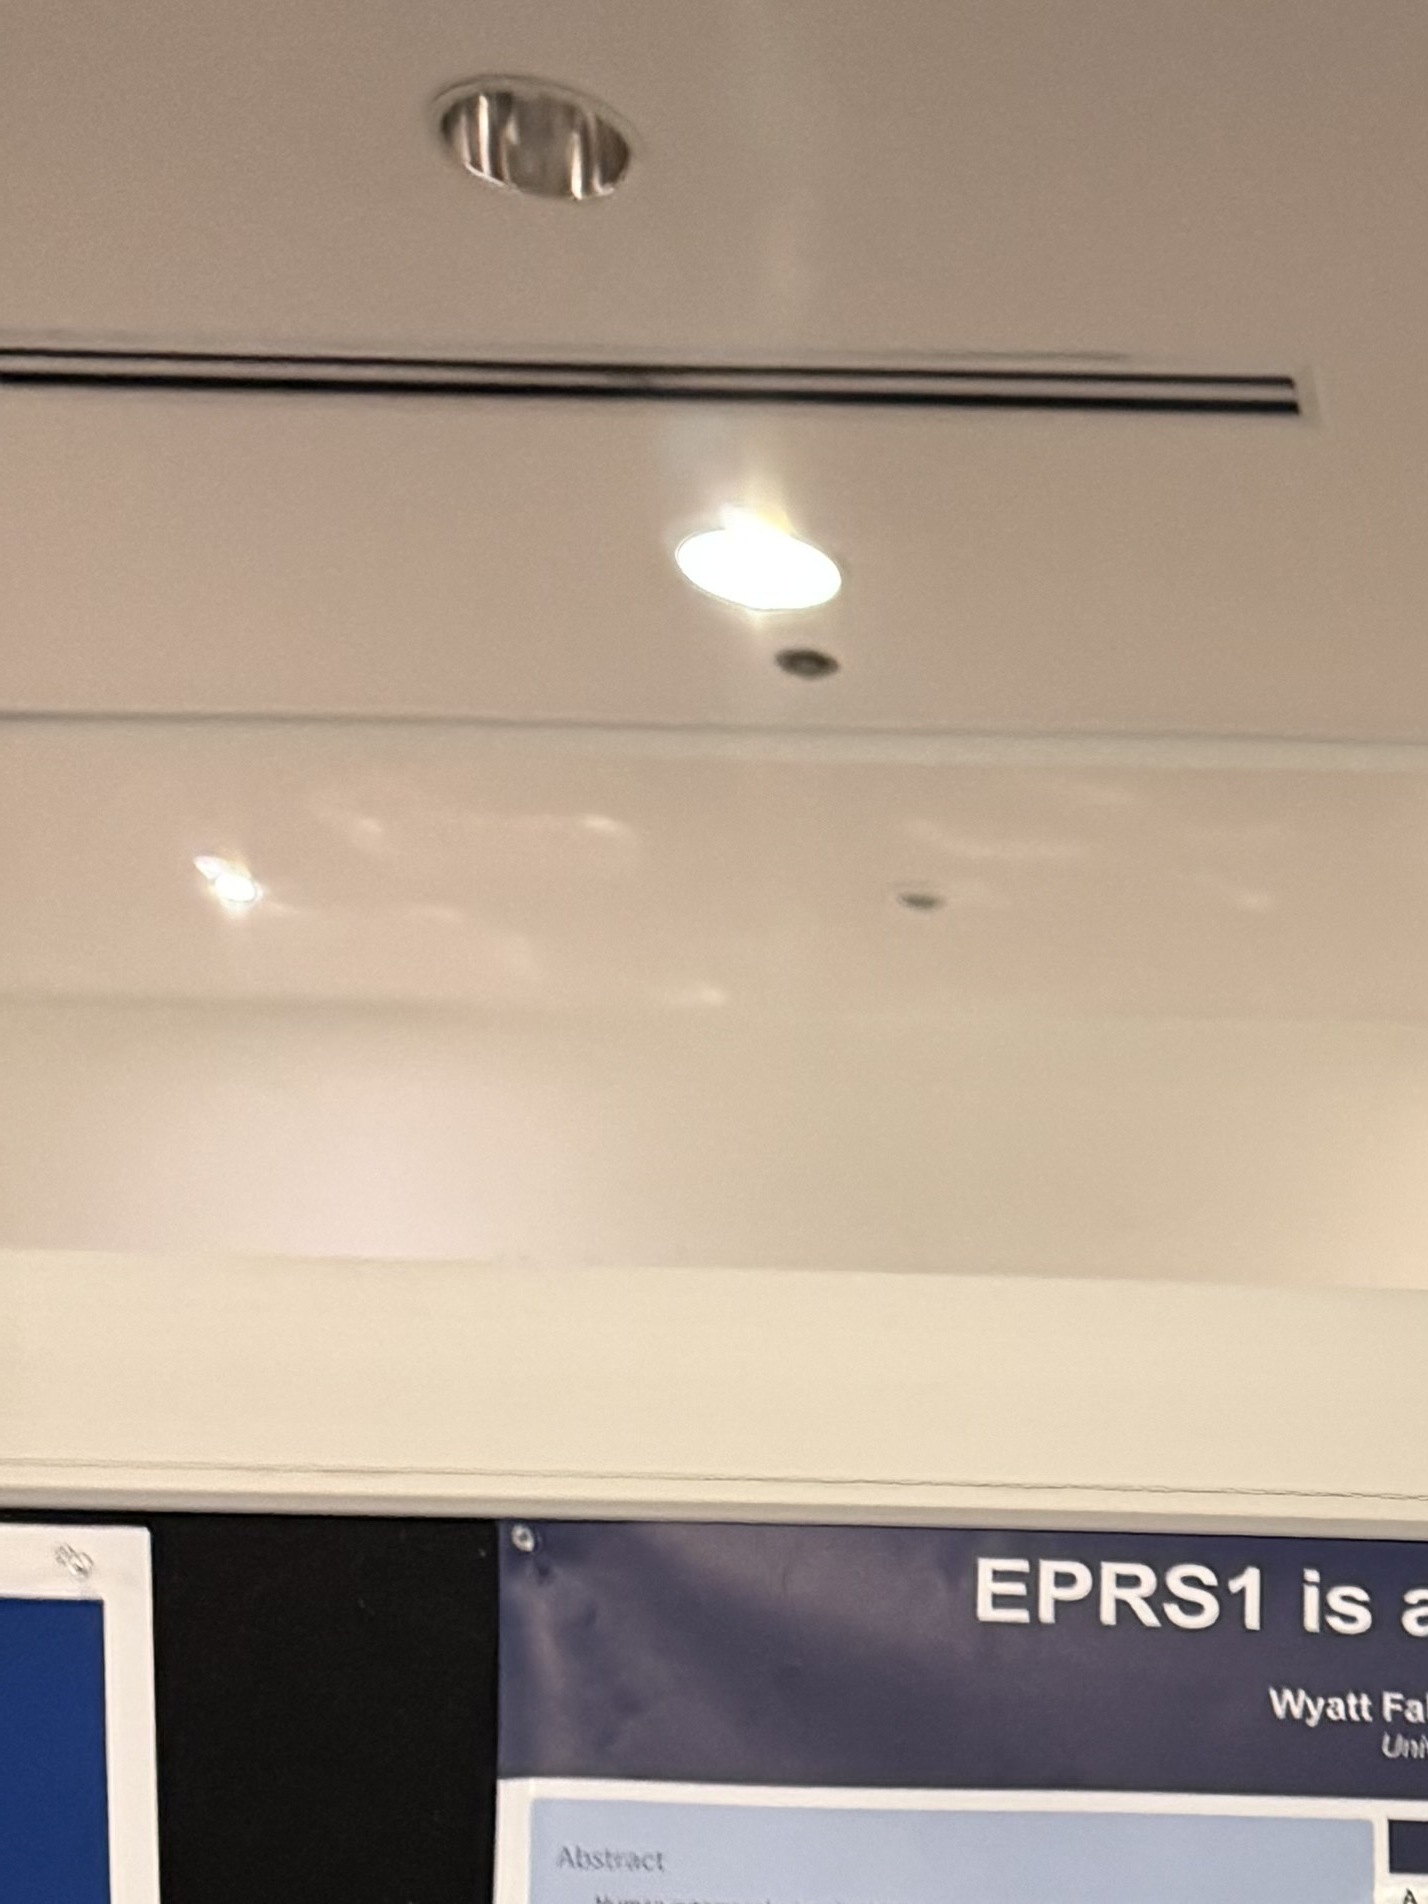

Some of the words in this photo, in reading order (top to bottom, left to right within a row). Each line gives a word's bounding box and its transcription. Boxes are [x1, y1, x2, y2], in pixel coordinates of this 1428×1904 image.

[976, 1557, 1261, 1630] EPRS1
[1303, 1569, 1372, 1635] is
[1269, 1688, 1373, 1727] Wyatt
[556, 1846, 664, 1872] Abstract
